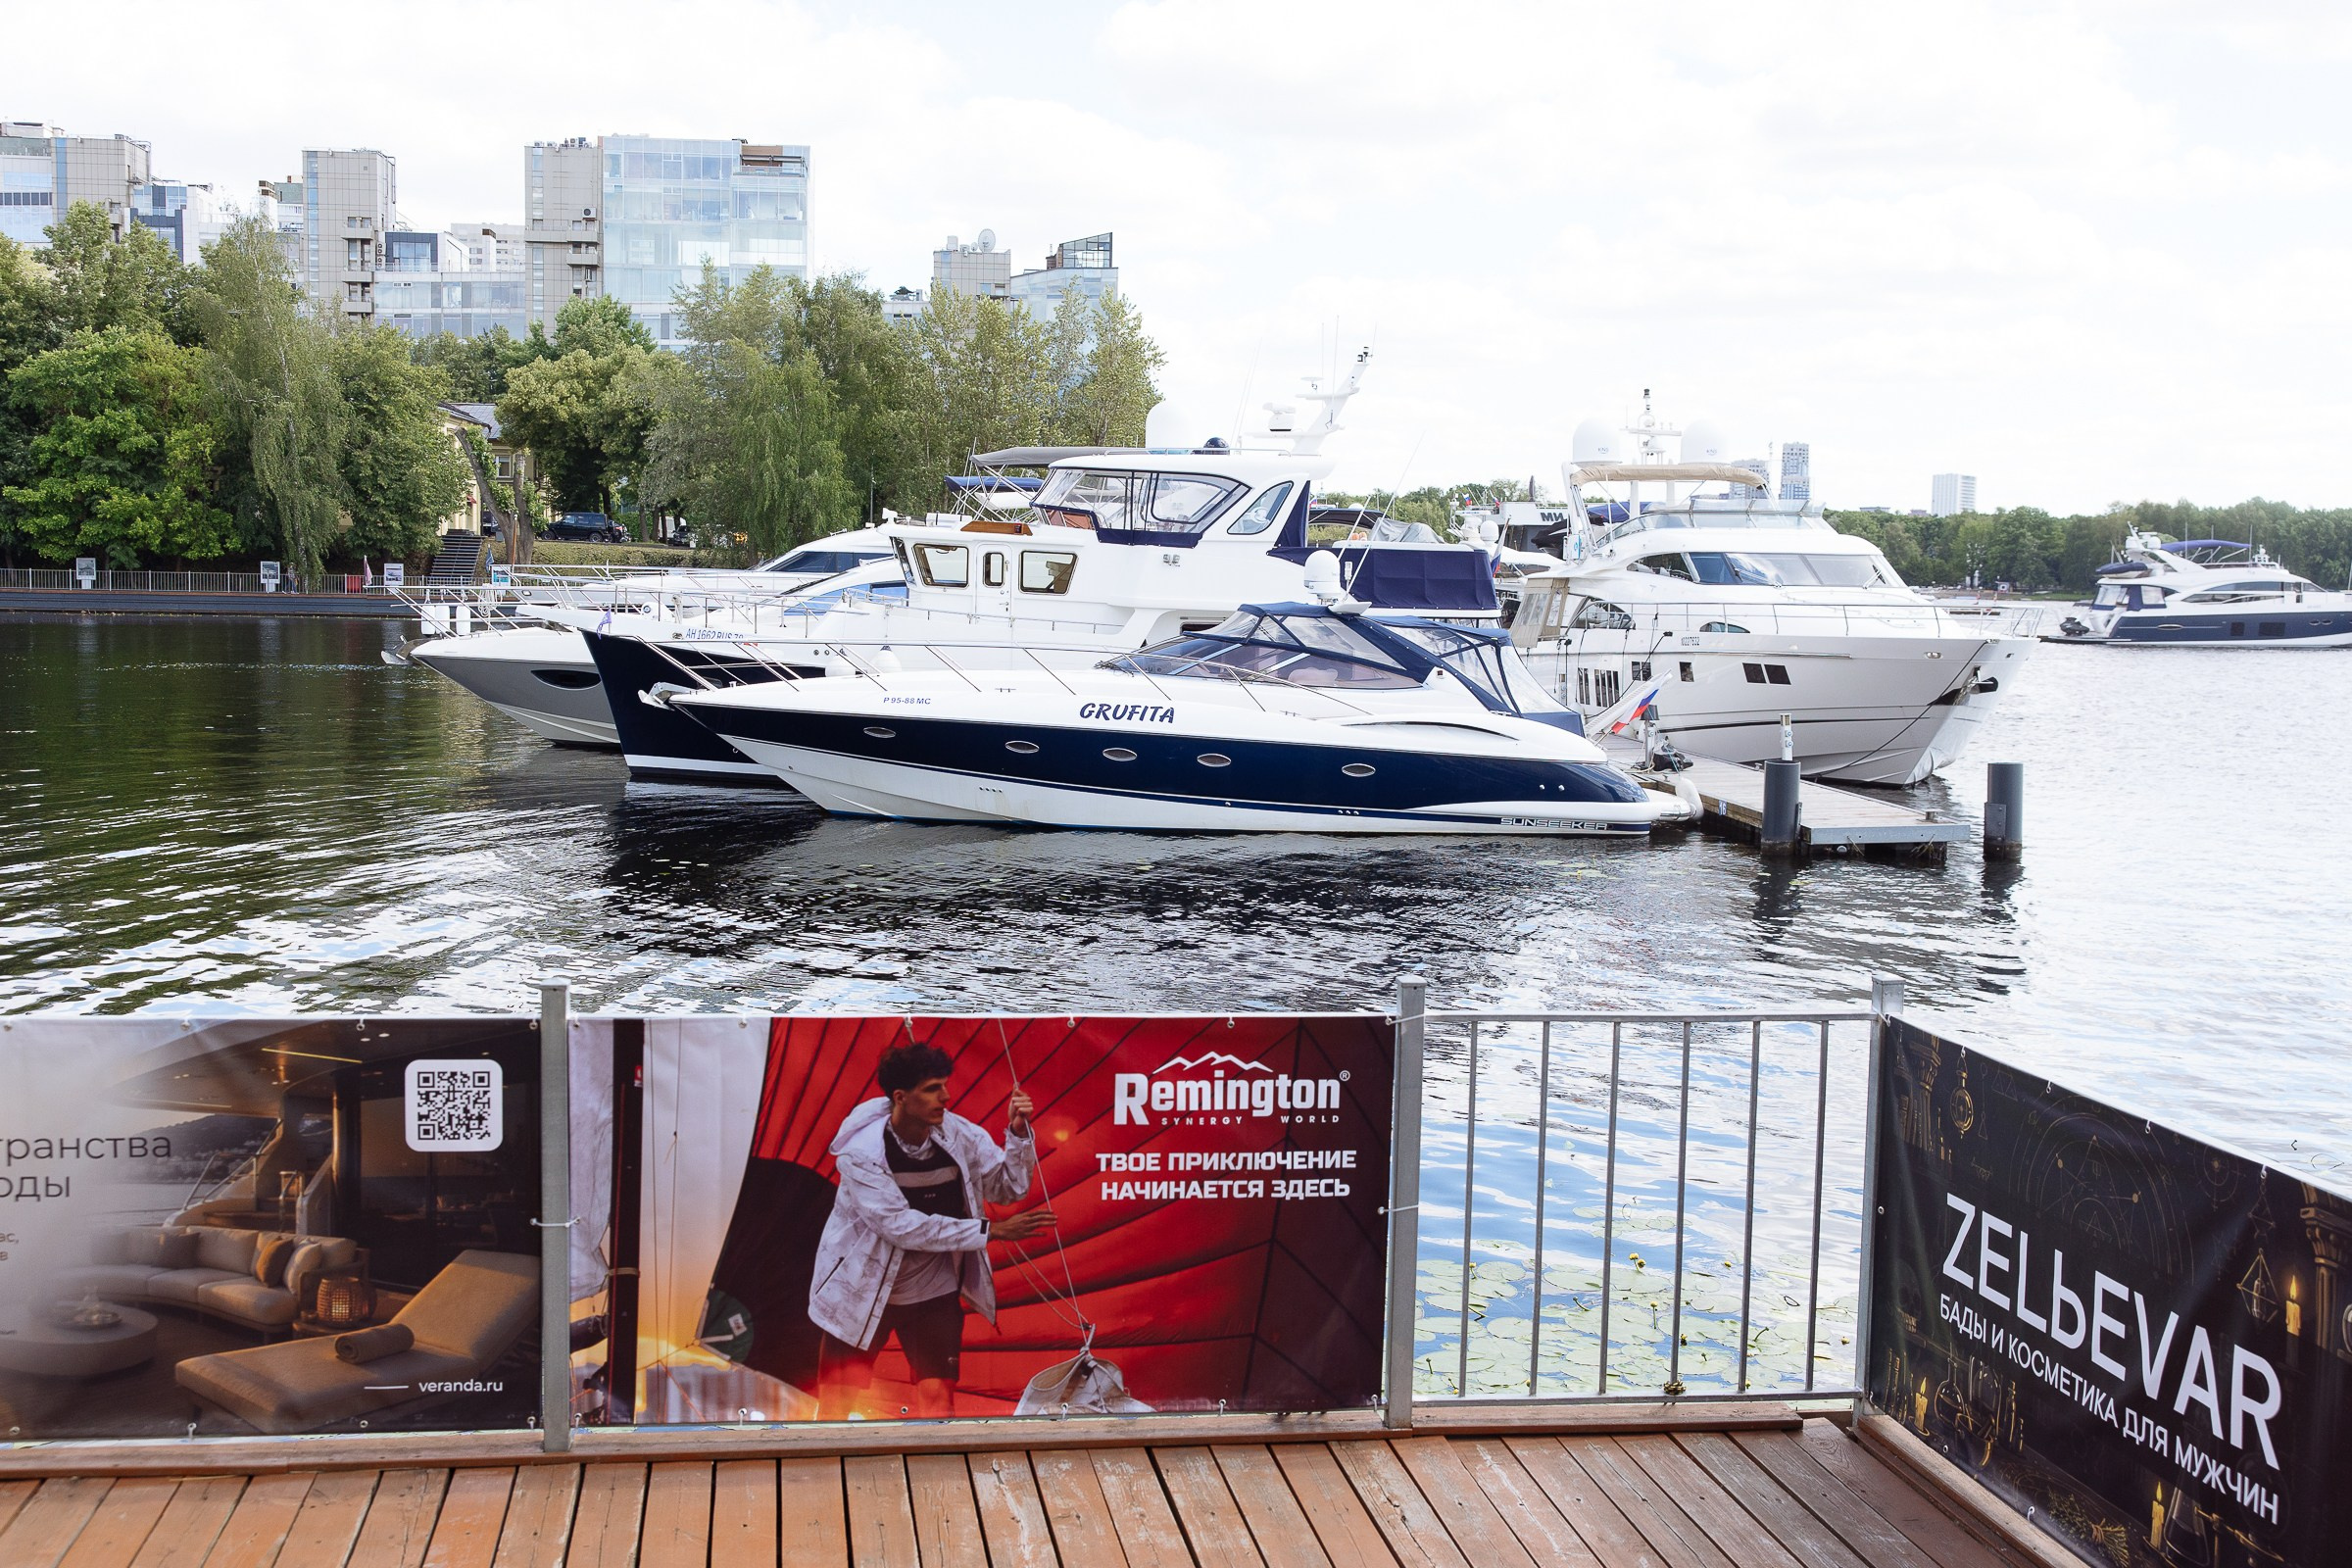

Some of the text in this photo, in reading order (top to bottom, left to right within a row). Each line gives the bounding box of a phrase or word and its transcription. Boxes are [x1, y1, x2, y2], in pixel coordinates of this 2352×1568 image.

[1079, 703, 1175, 724] GRUFITA
[1499, 817, 1608, 831] SUNSEEKER
[1161, 1114, 1341, 1126] SYNERGY WORLD
[0, 1136, 172, 1167] ранства
[1095, 1150, 1358, 1172] ТВОЕ ПРИКЛЮЧЕНИЕ
[1101, 1178, 1351, 1200] НАЧИНАЕТСЯ ЗДЕСЬ
[417, 1378, 504, 1393] veranda.ru
[1939, 1292, 2279, 1526] БАДЫ И КОСМЕТИКА ДЛЯ МУЖЧИН
